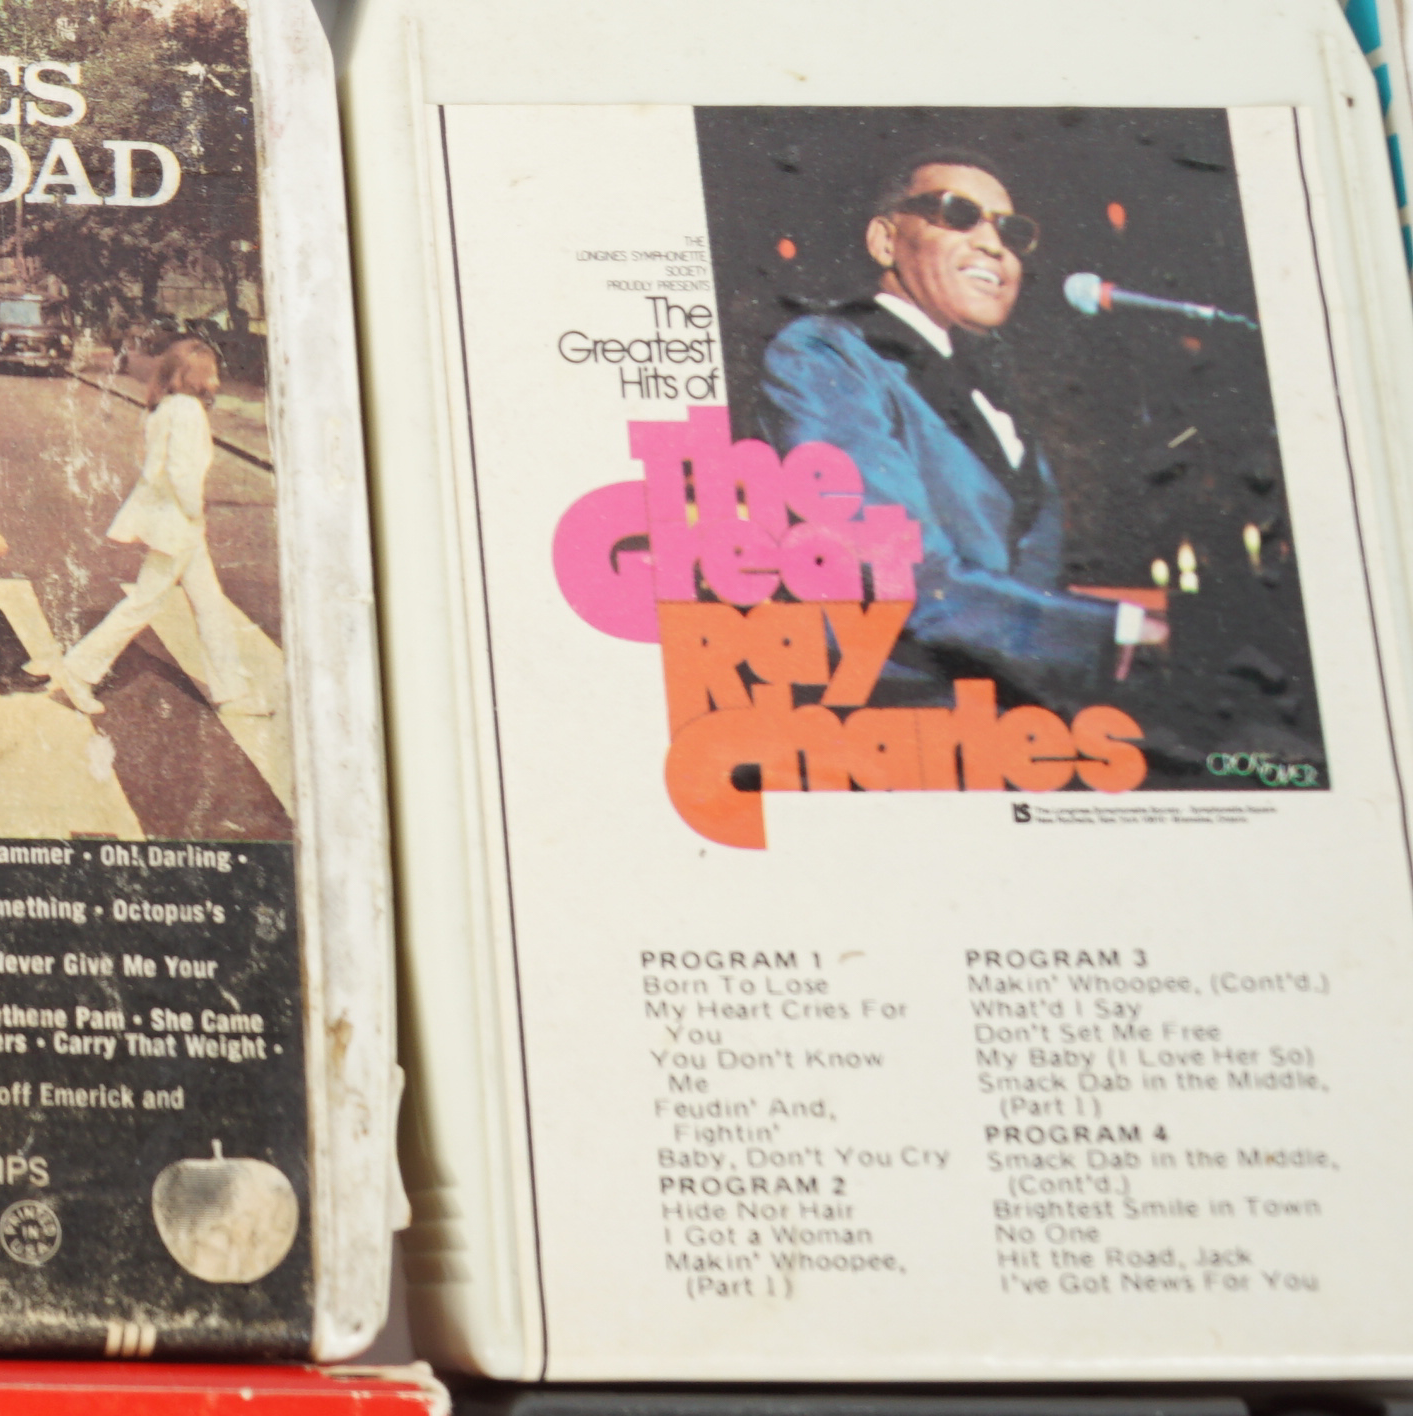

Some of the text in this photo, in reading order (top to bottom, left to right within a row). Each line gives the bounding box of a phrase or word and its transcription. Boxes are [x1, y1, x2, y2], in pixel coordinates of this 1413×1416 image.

[576, 250, 707, 263] LONGINES SYMPHONETTE
[665, 265, 707, 277] SOCIETY
[607, 280, 710, 292] PROUDLY PRESENTS
[644, 296, 713, 329] The
[558, 330, 716, 364] Greatest
[619, 366, 720, 400] Hits of
[100, 846, 139, 867] Oh!
[149, 845, 233, 872] Darling
[641, 951, 820, 969] PROGRAM 1
[966, 949, 1147, 968] PROGRAM 3
[643, 975, 828, 995] Born To Lose
[645, 999, 906, 1023] My Heart Cries For
[660, 1176, 845, 1195] PROGRAM 2
[998, 1248, 1251, 1269] Hit the Road, Jack
